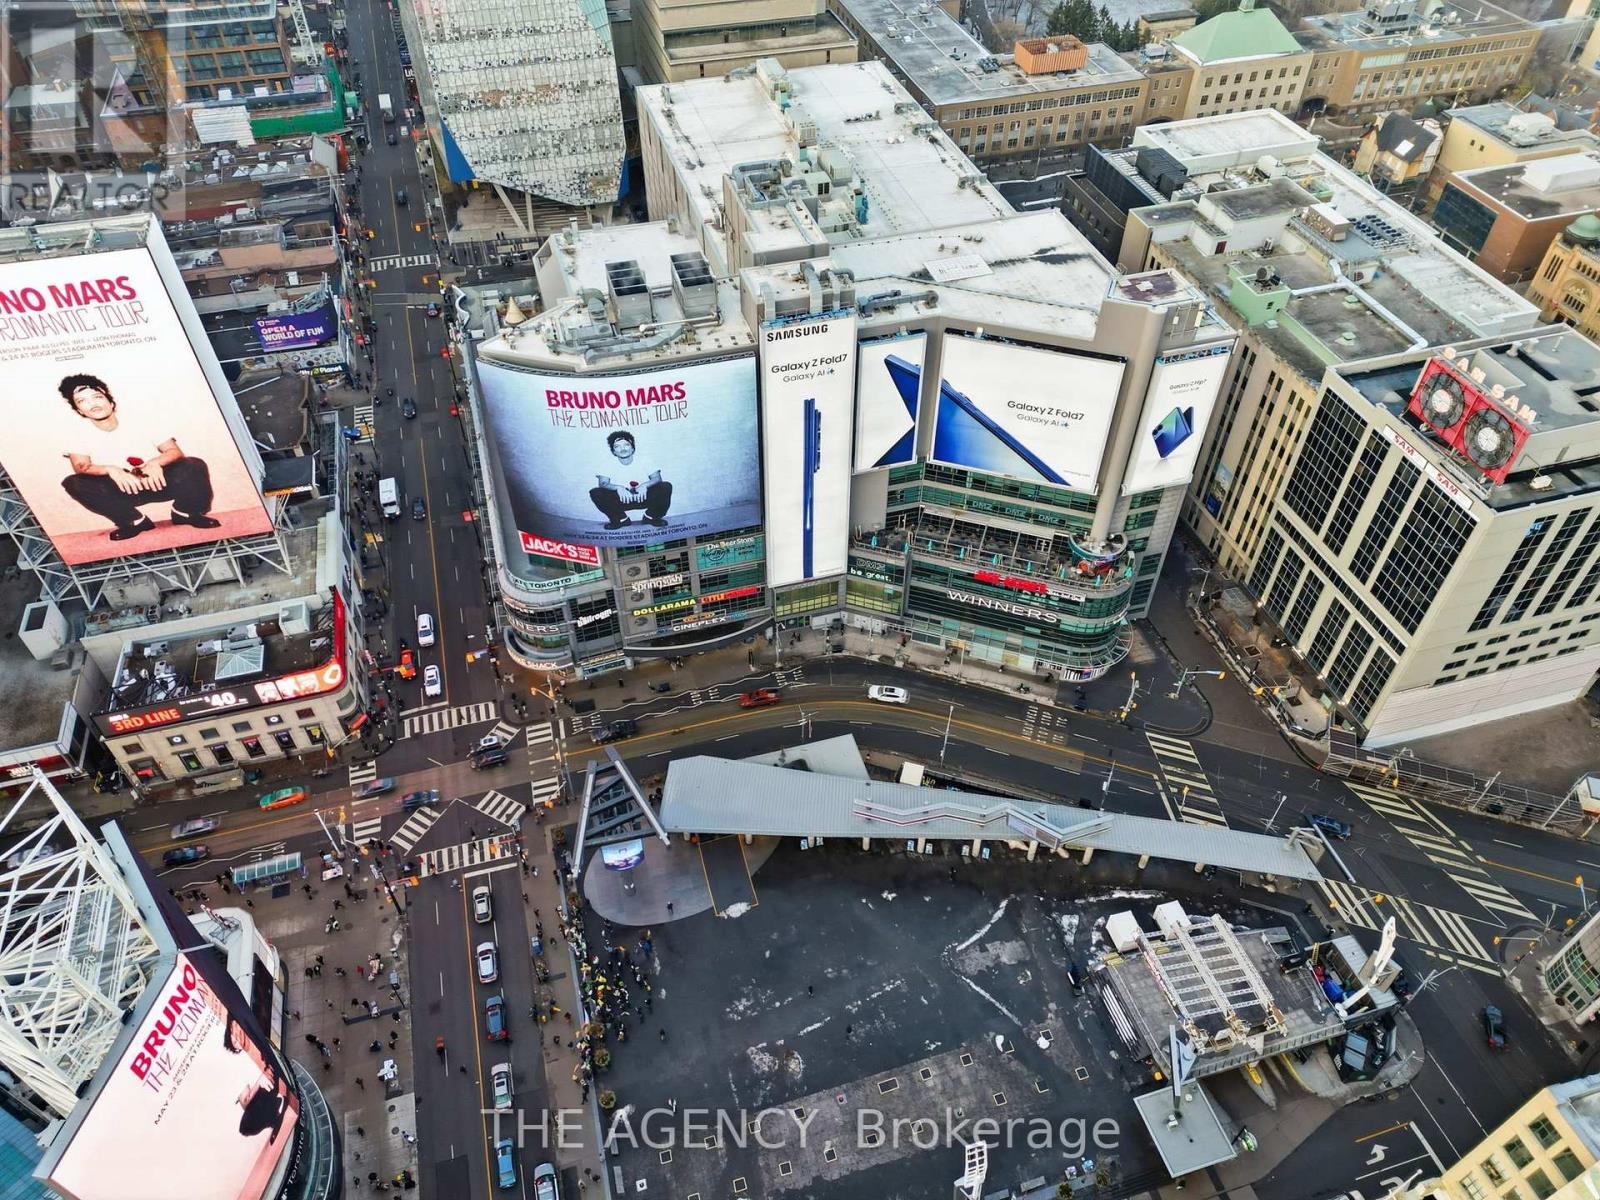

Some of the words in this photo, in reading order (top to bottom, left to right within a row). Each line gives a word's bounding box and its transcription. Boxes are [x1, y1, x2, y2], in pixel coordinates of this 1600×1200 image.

[0, 286, 47, 315] NO
[47, 275, 137, 309] MARS
[94, 300, 149, 328] TOUR
[261, 325, 287, 334] OPEN
[263, 331, 294, 342] WORLD
[294, 329, 306, 338] OF
[306, 326, 325, 337] FUN
[766, 324, 829, 342] SAMSUNG
[771, 359, 811, 374] Galaxy
[812, 358, 818, 367] Z
[819, 353, 848, 366] Fold7
[783, 371, 815, 383] Galaxy
[545, 389, 621, 410] BRUNO
[626, 381, 686, 408] MARS
[548, 408, 577, 428] THE
[580, 408, 649, 428] ROMANTIC
[654, 400, 689, 422] TOUR
[1007, 400, 1046, 416] Galaxy
[1047, 407, 1054, 416] Z
[1055, 408, 1085, 421] Fold7
[1016, 413, 1049, 426] Galaxy
[1394, 434, 1415, 457] SAM
[1436, 473, 1459, 496] SAM
[972, 500, 993, 511] DMZ
[633, 531, 660, 540] STADIUM
[525, 537, 578, 558] JACK'S
[850, 567, 863, 576] be
[865, 571, 892, 582] great.
[856, 558, 886, 571] DMZ
[529, 577, 572, 588] TORONTO
[633, 599, 696, 616] DOLLARAMA
[947, 590, 1058, 623] WINNERS
[673, 616, 727, 632] CINEPLEX
[114, 716, 144, 732] 3RD
[145, 708, 180, 724] LINE
[130, 963, 196, 1081] BRUNO
[154, 1100, 169, 1125] MAY
[288, 1131, 304, 1185] Toronto
